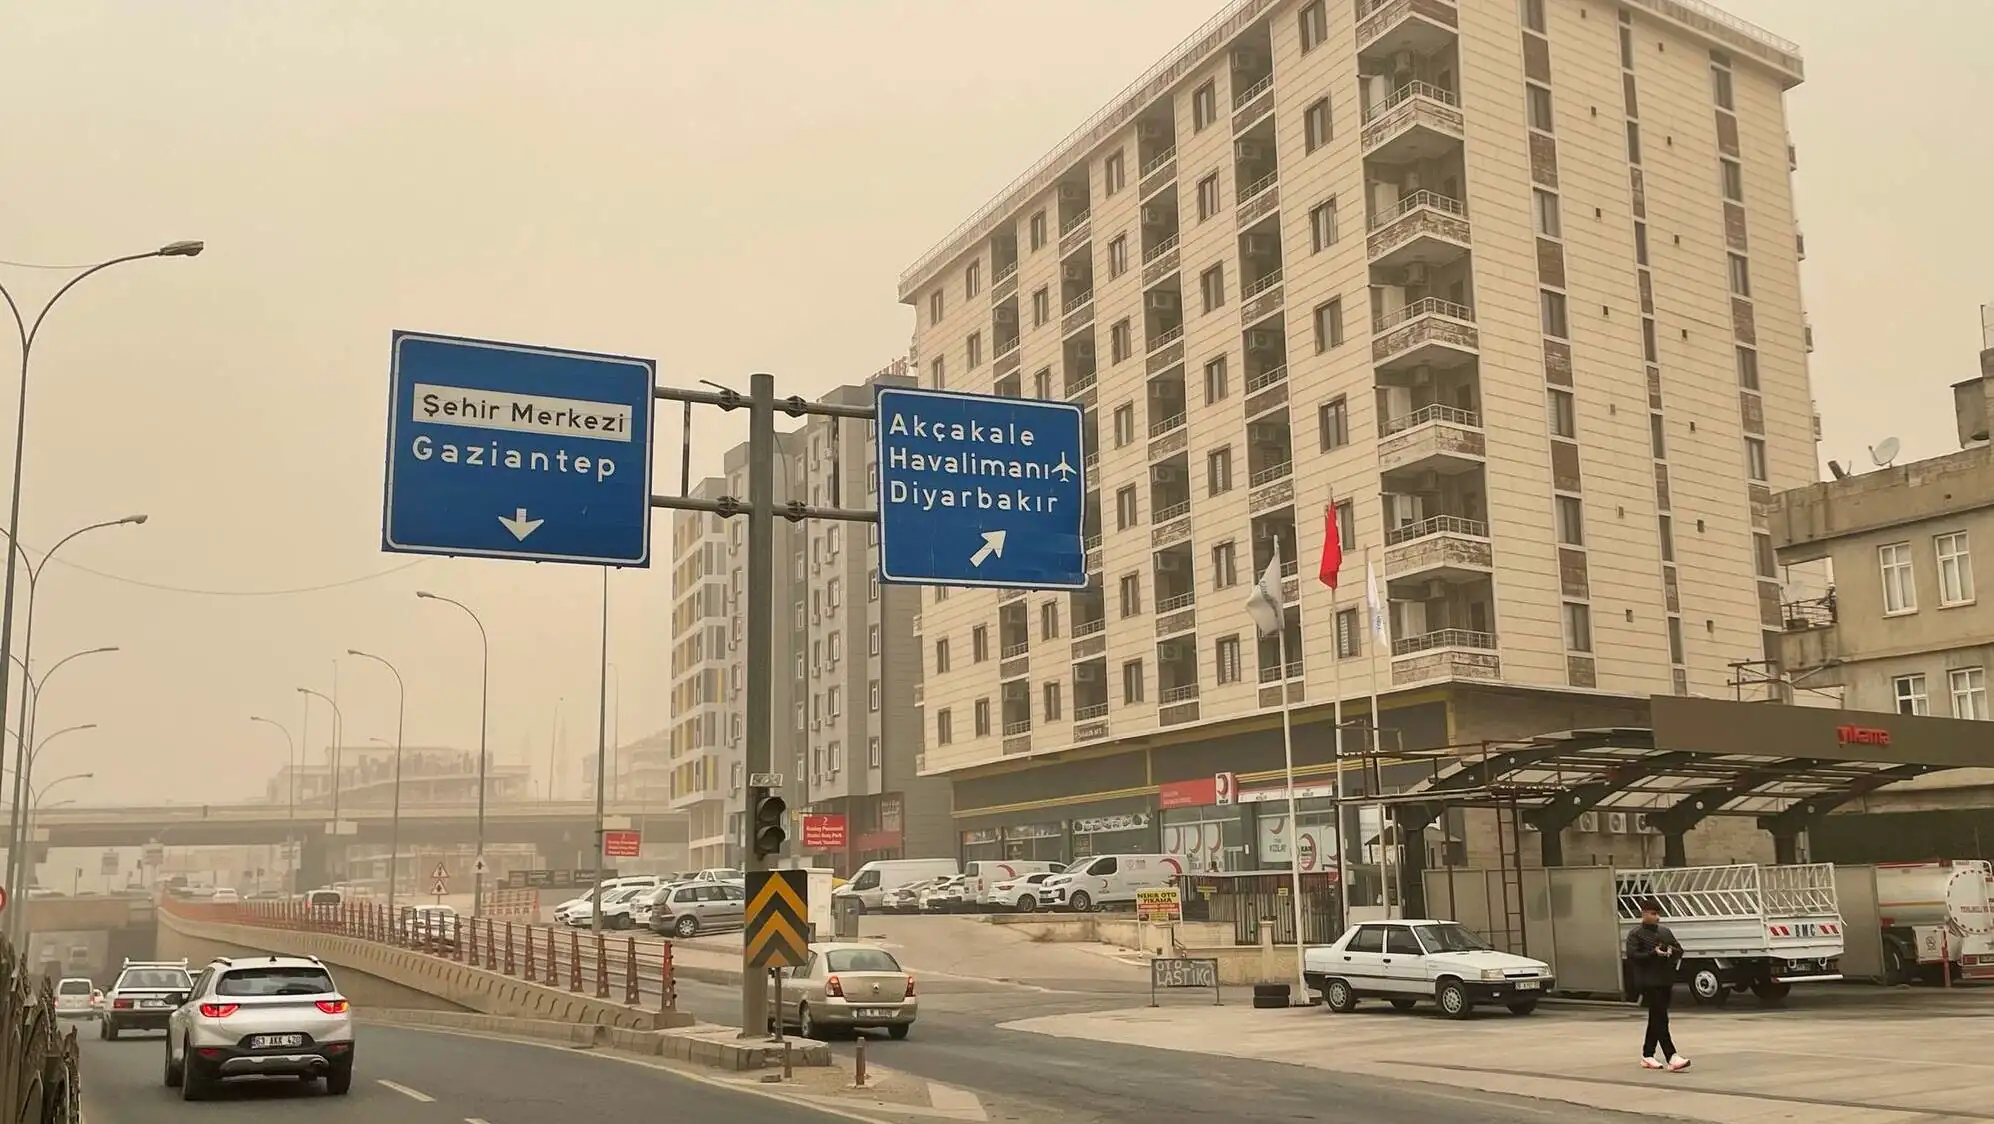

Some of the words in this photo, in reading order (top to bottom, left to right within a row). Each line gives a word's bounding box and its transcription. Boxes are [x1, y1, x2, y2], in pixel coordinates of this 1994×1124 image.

[423, 393, 500, 420] Şehir
[511, 402, 624, 433] Merkezi
[889, 413, 1035, 446] Akçakale
[412, 435, 616, 483] Gaziantep
[889, 446, 1049, 480] Havalimanı
[890, 480, 1059, 513] Diyarbakır
[1795, 924, 1816, 937] BMC
[1156, 960, 1182, 971] OTO
